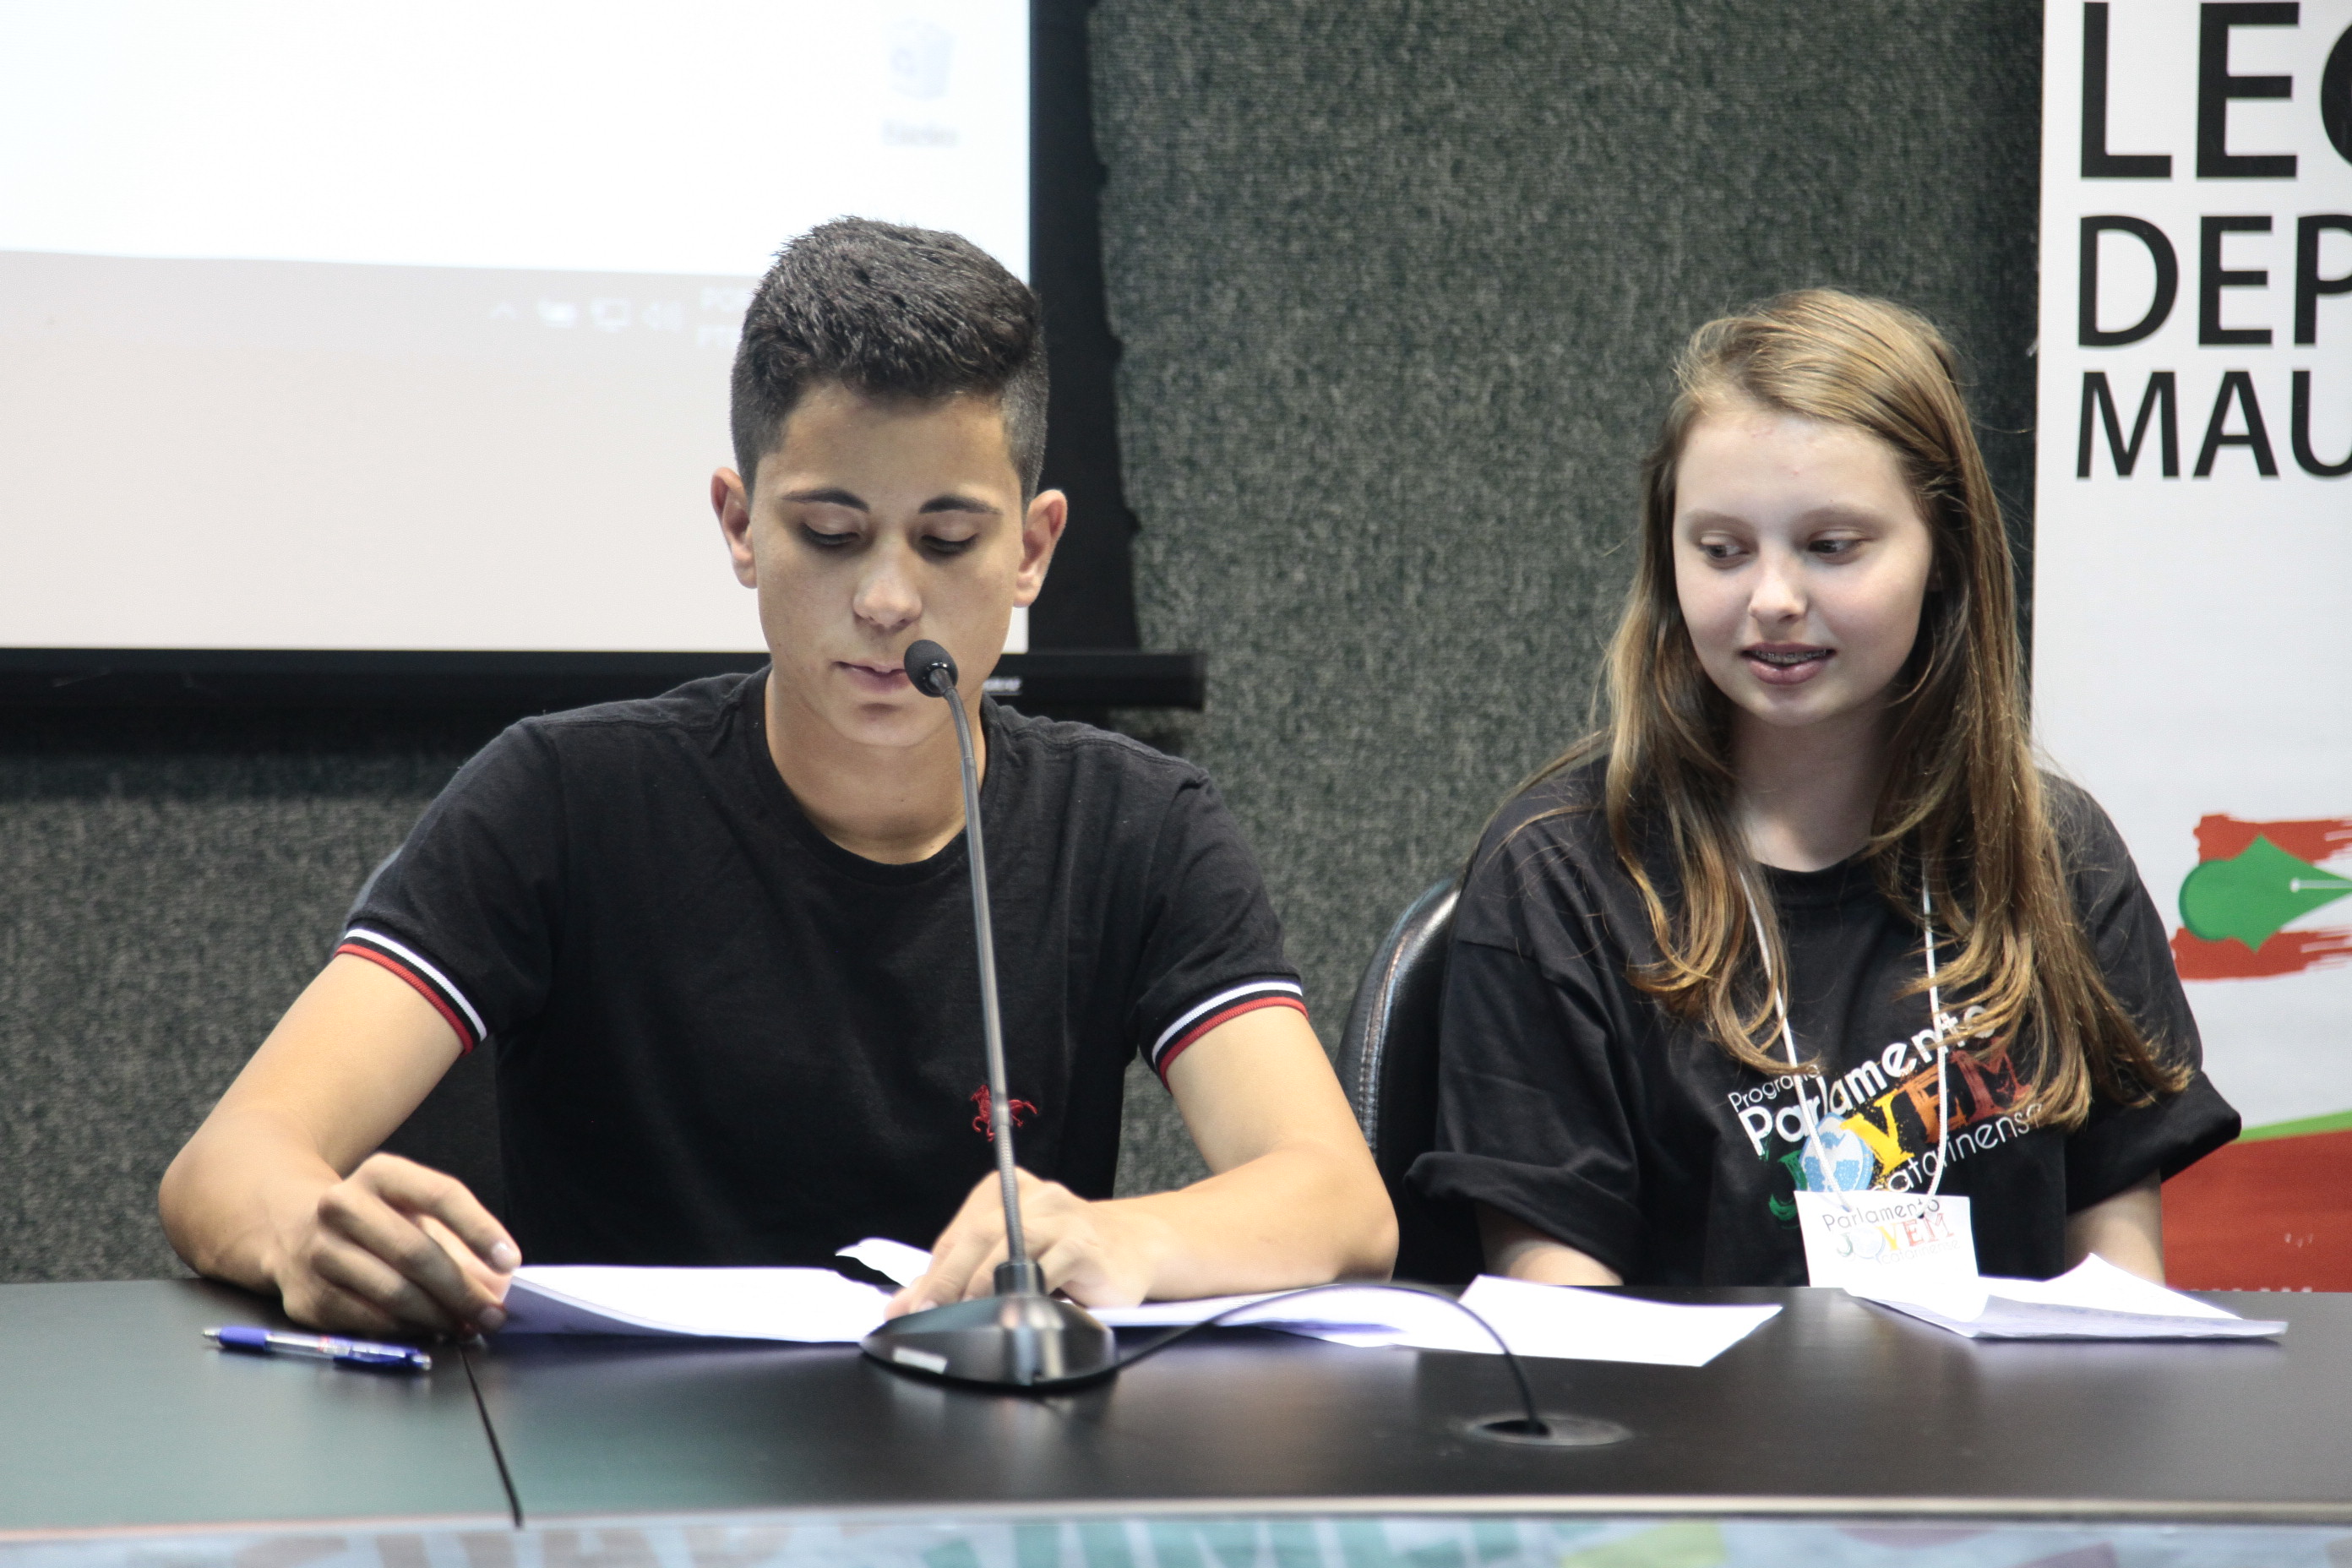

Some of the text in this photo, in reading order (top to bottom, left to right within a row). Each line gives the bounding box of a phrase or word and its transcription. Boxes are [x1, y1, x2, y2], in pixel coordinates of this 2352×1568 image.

[2078, 215, 2352, 347] DEP
[2077, 369, 2352, 479] MAU
[1728, 1064, 1821, 1113] Prograa
